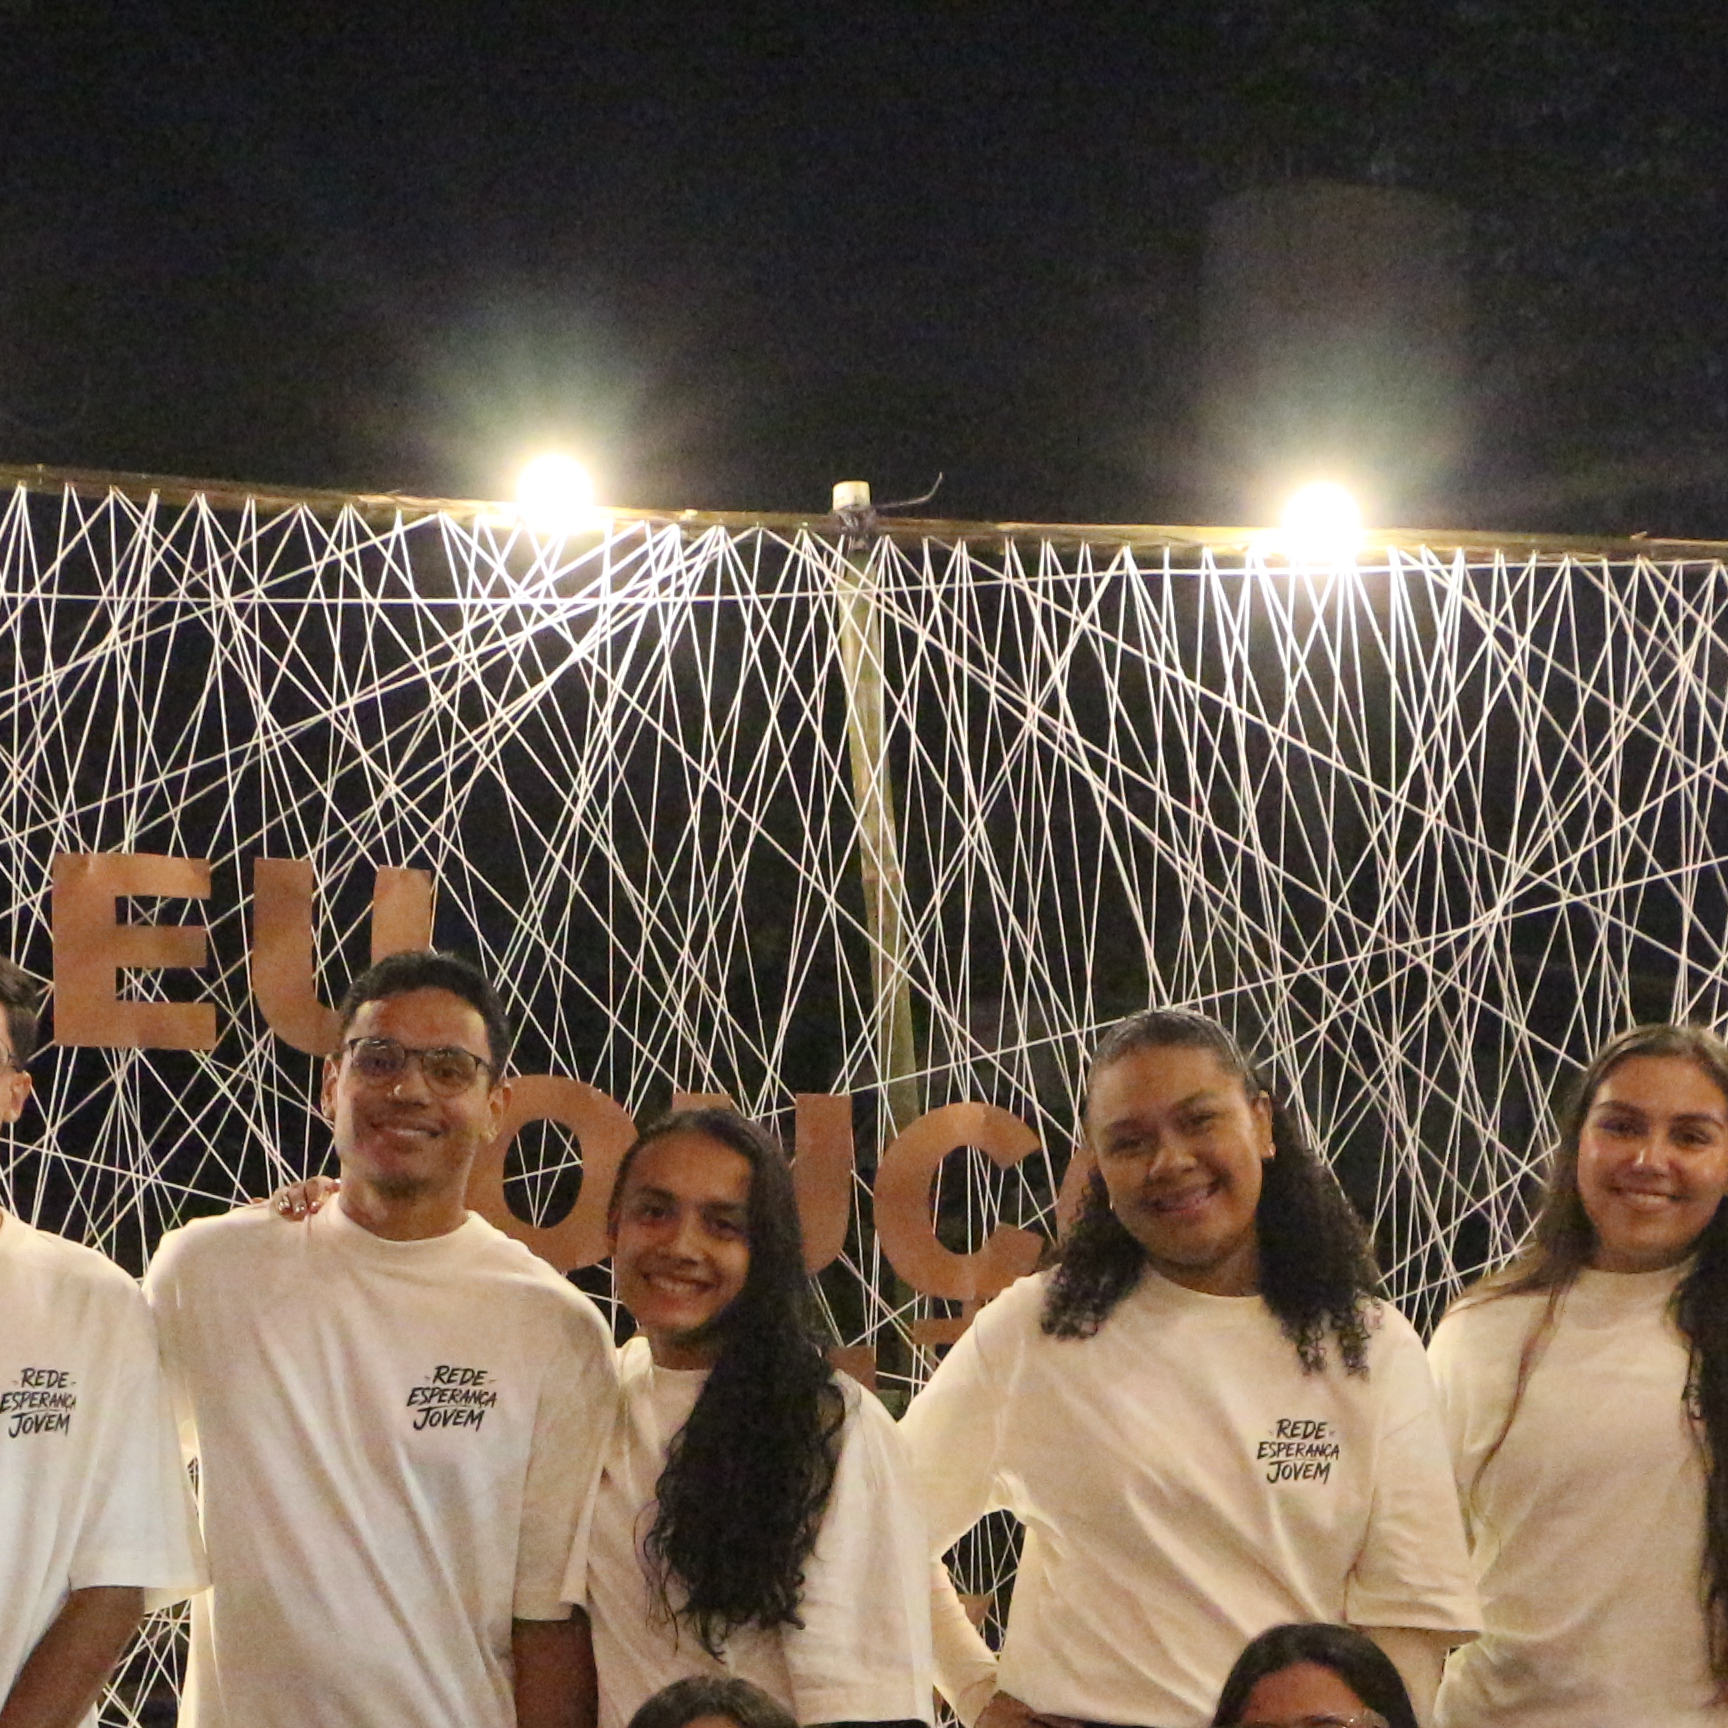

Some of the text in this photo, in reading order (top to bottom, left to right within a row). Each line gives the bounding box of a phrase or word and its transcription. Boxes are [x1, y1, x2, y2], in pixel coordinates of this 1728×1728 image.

[51, 851, 433, 1057] EU
[21, 1367, 70, 1389] REDE
[433, 1365, 488, 1386] REDE
[406, 1386, 498, 1408] ESPERANÇA
[8, 1413, 71, 1439] JOVEM
[413, 1406, 485, 1432] JOVEM
[1276, 1418, 1328, 1440] REDE
[1257, 1441, 1340, 1461] ESPERANÇA
[1266, 1460, 1332, 1485] JOVEM
